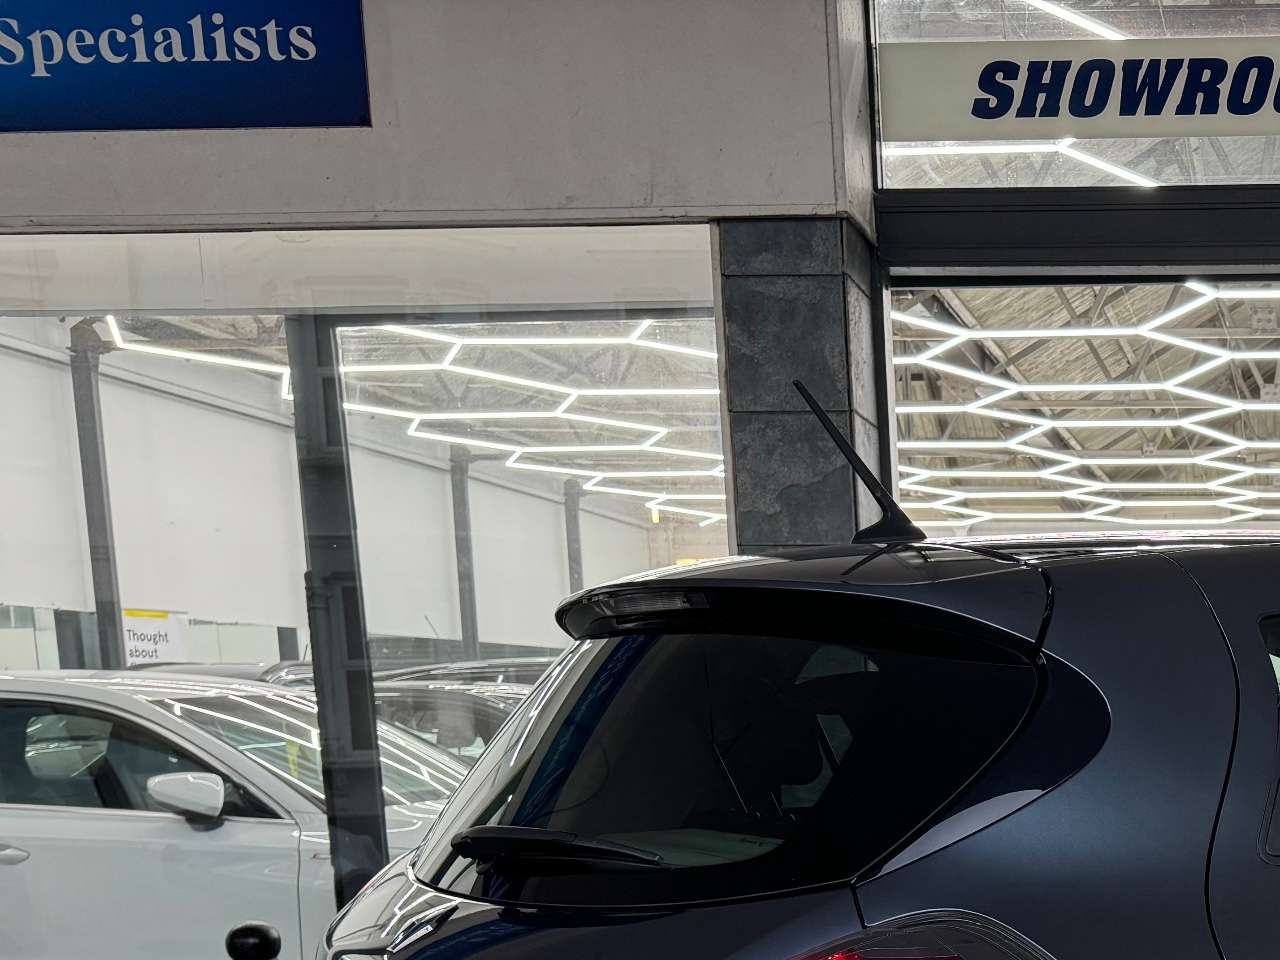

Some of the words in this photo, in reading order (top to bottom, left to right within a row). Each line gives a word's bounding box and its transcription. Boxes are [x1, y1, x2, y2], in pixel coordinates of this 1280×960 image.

[0, 12, 318, 77] Specialists
[126, 629, 169, 646] Thought
[128, 645, 159, 658] about
